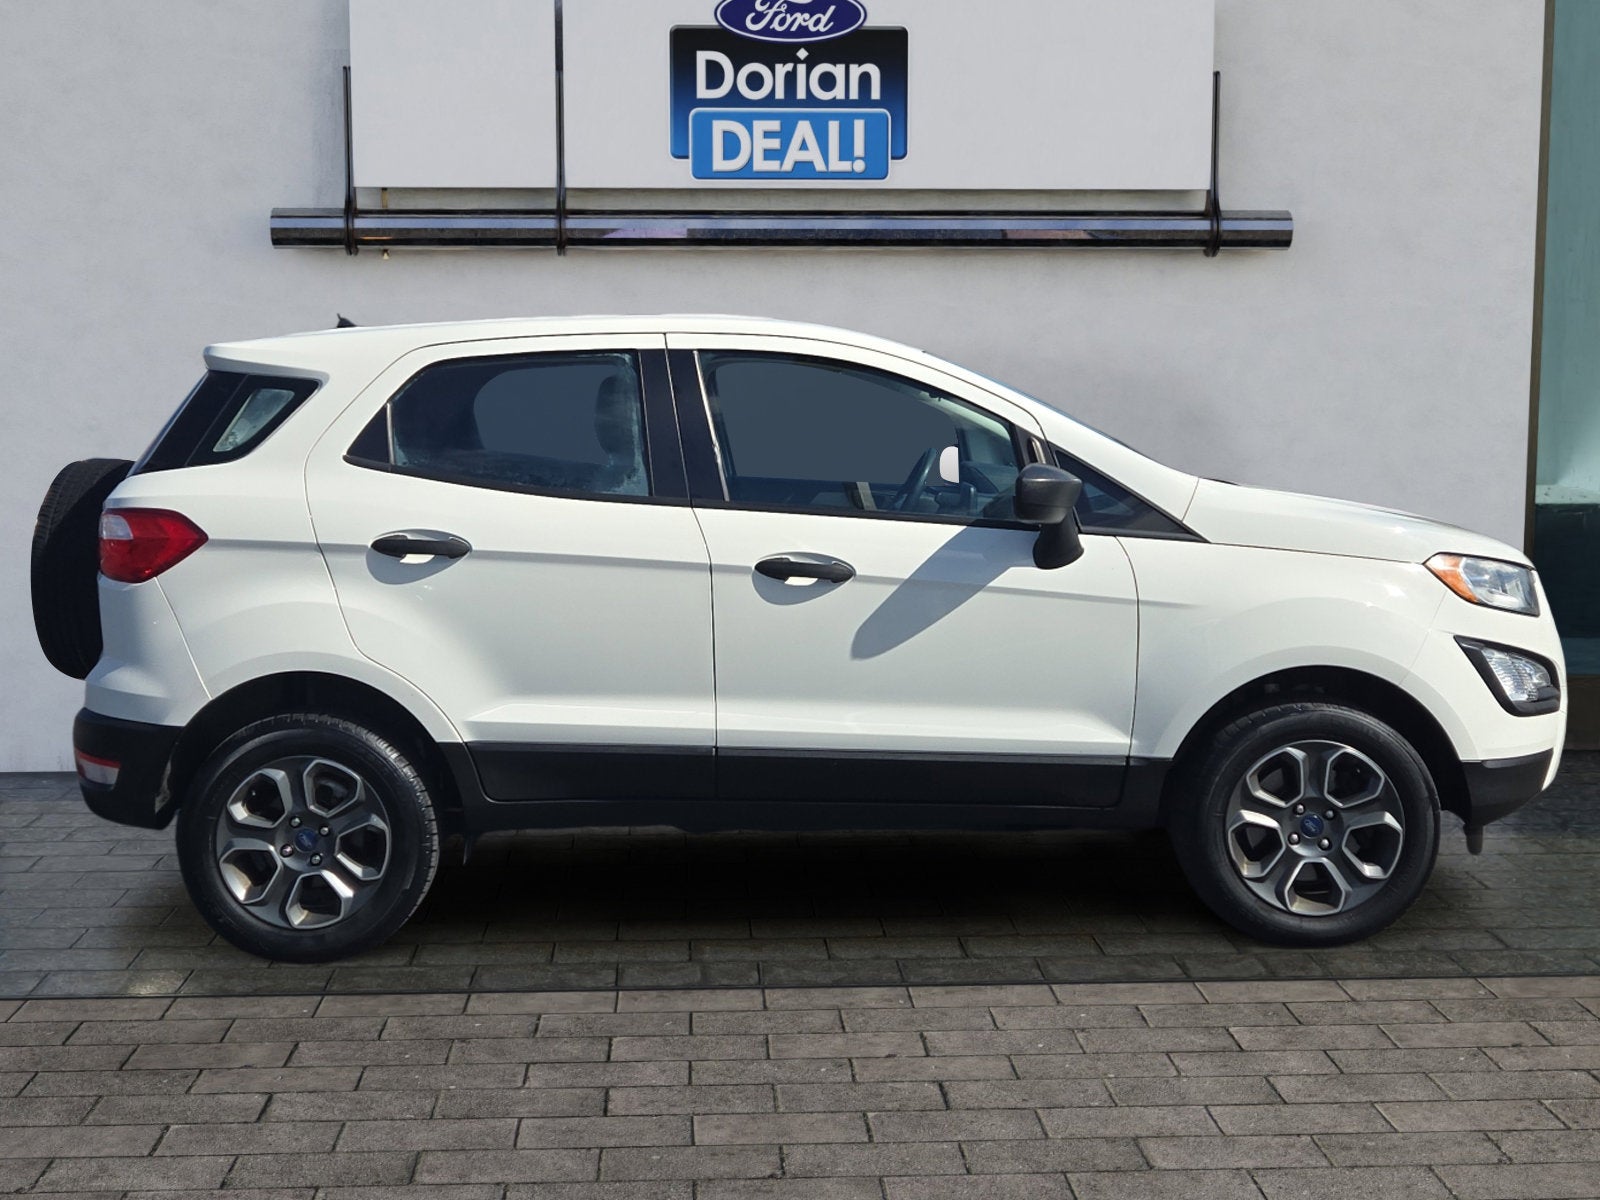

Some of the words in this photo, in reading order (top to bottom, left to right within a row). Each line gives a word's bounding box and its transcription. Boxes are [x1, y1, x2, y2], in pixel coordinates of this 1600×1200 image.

[745, 0, 836, 32] Ford
[696, 48, 881, 100] Dorian
[712, 119, 866, 173] DEAL!
